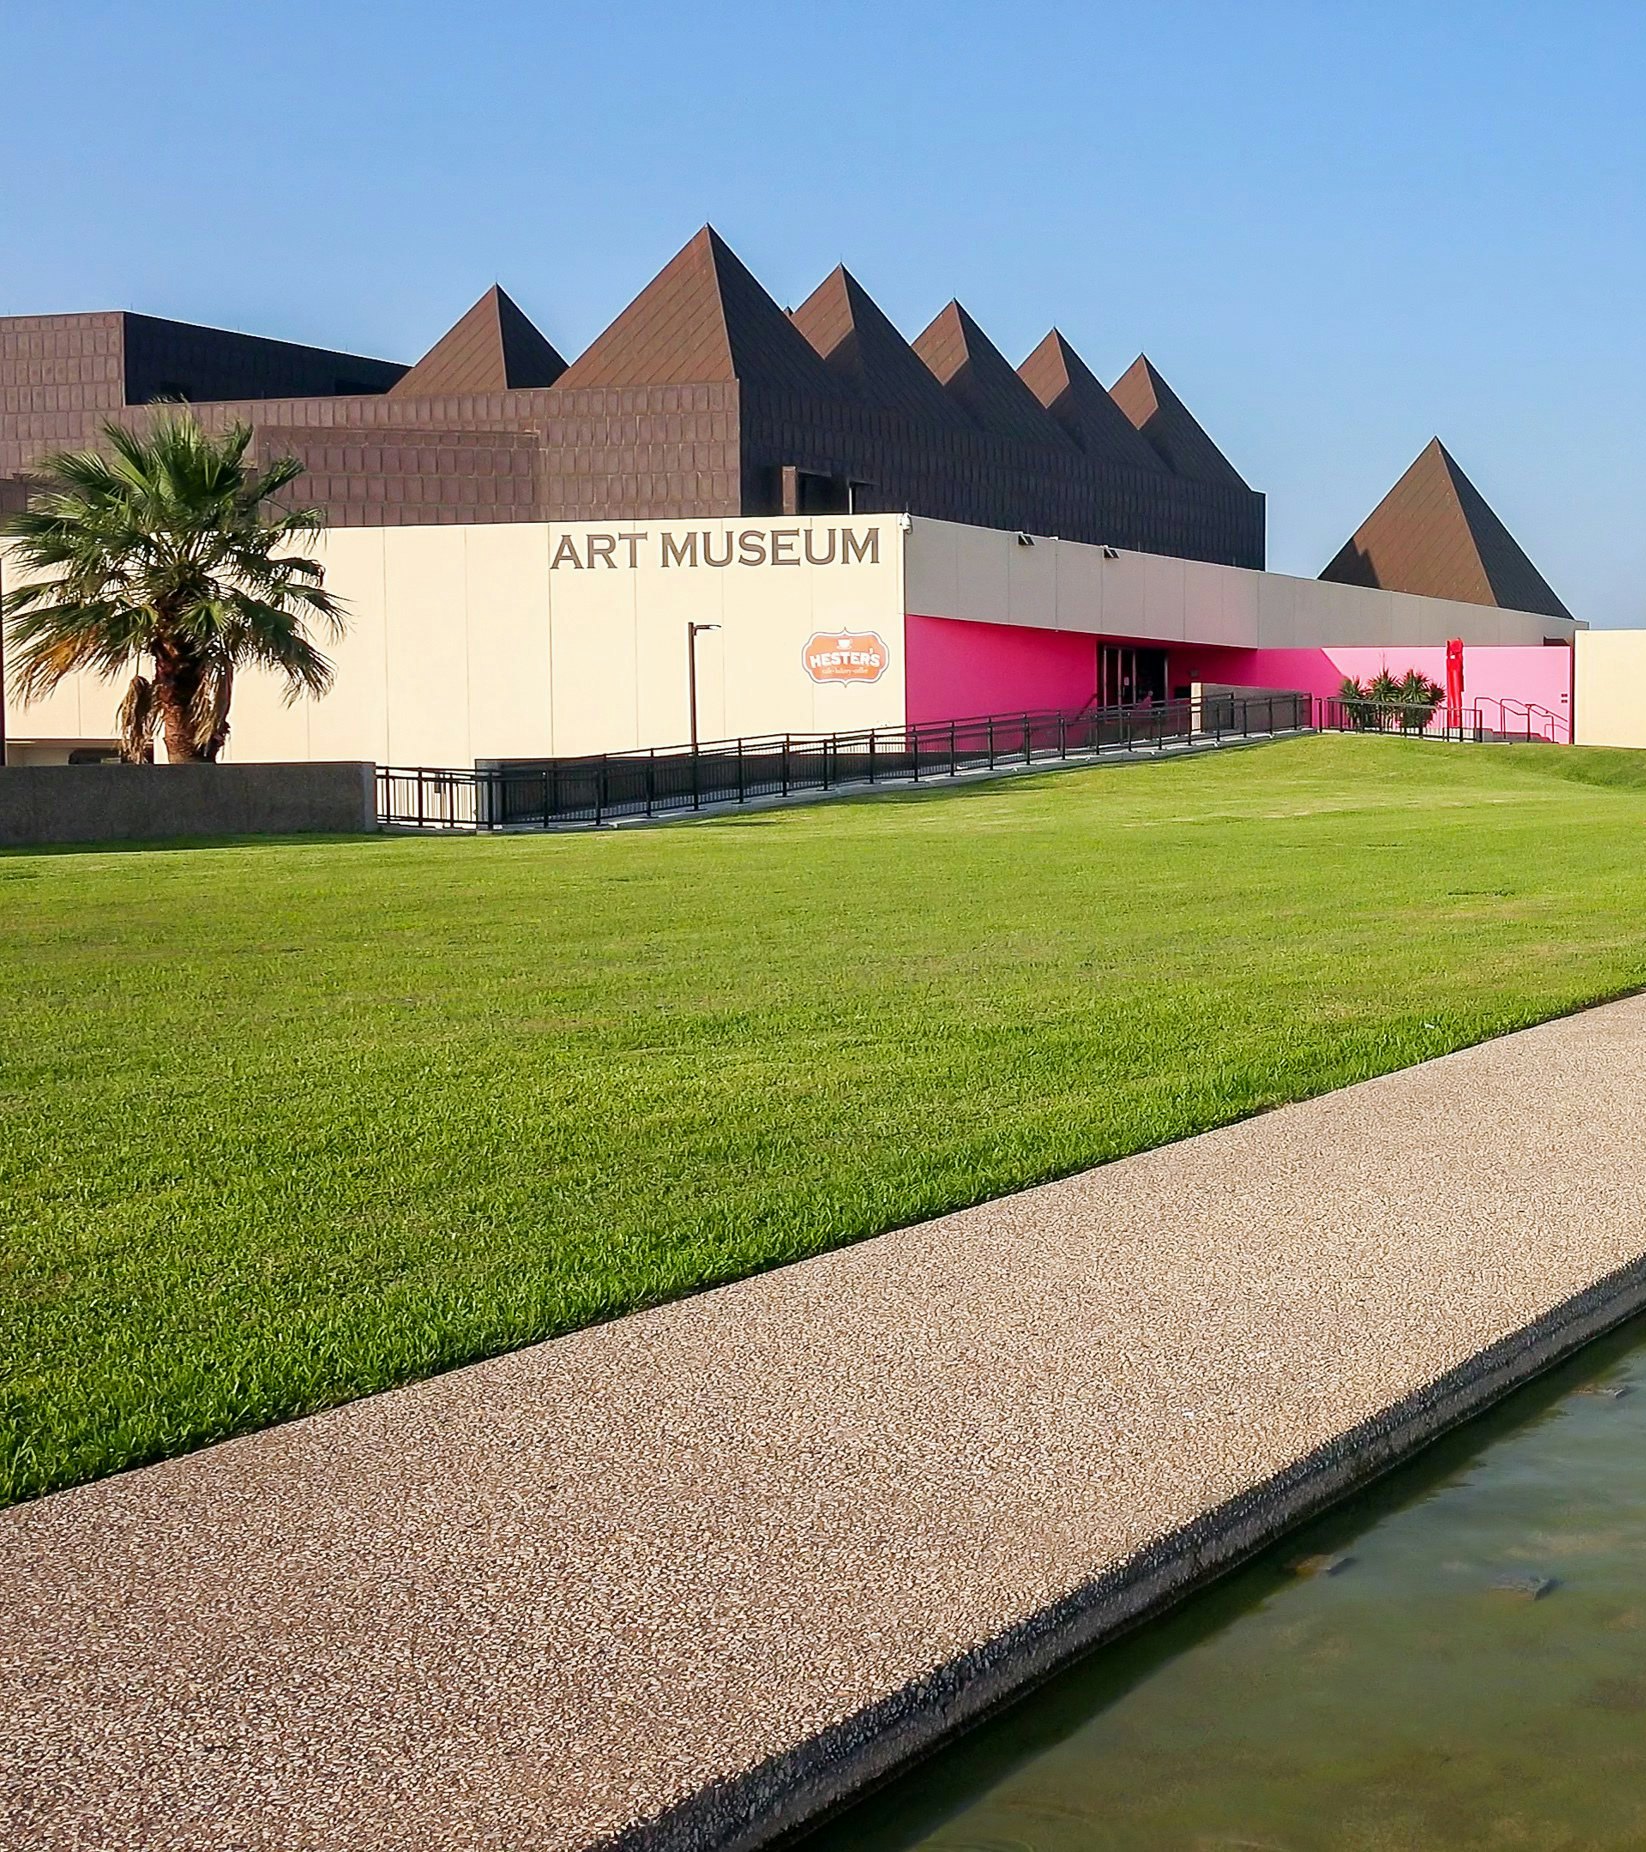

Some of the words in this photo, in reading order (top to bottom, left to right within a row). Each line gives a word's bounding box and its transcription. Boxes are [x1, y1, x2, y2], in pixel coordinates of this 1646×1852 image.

[550, 532, 648, 569] ART
[661, 528, 880, 568] MUSEUM
[810, 648, 879, 668] HESTER'S
